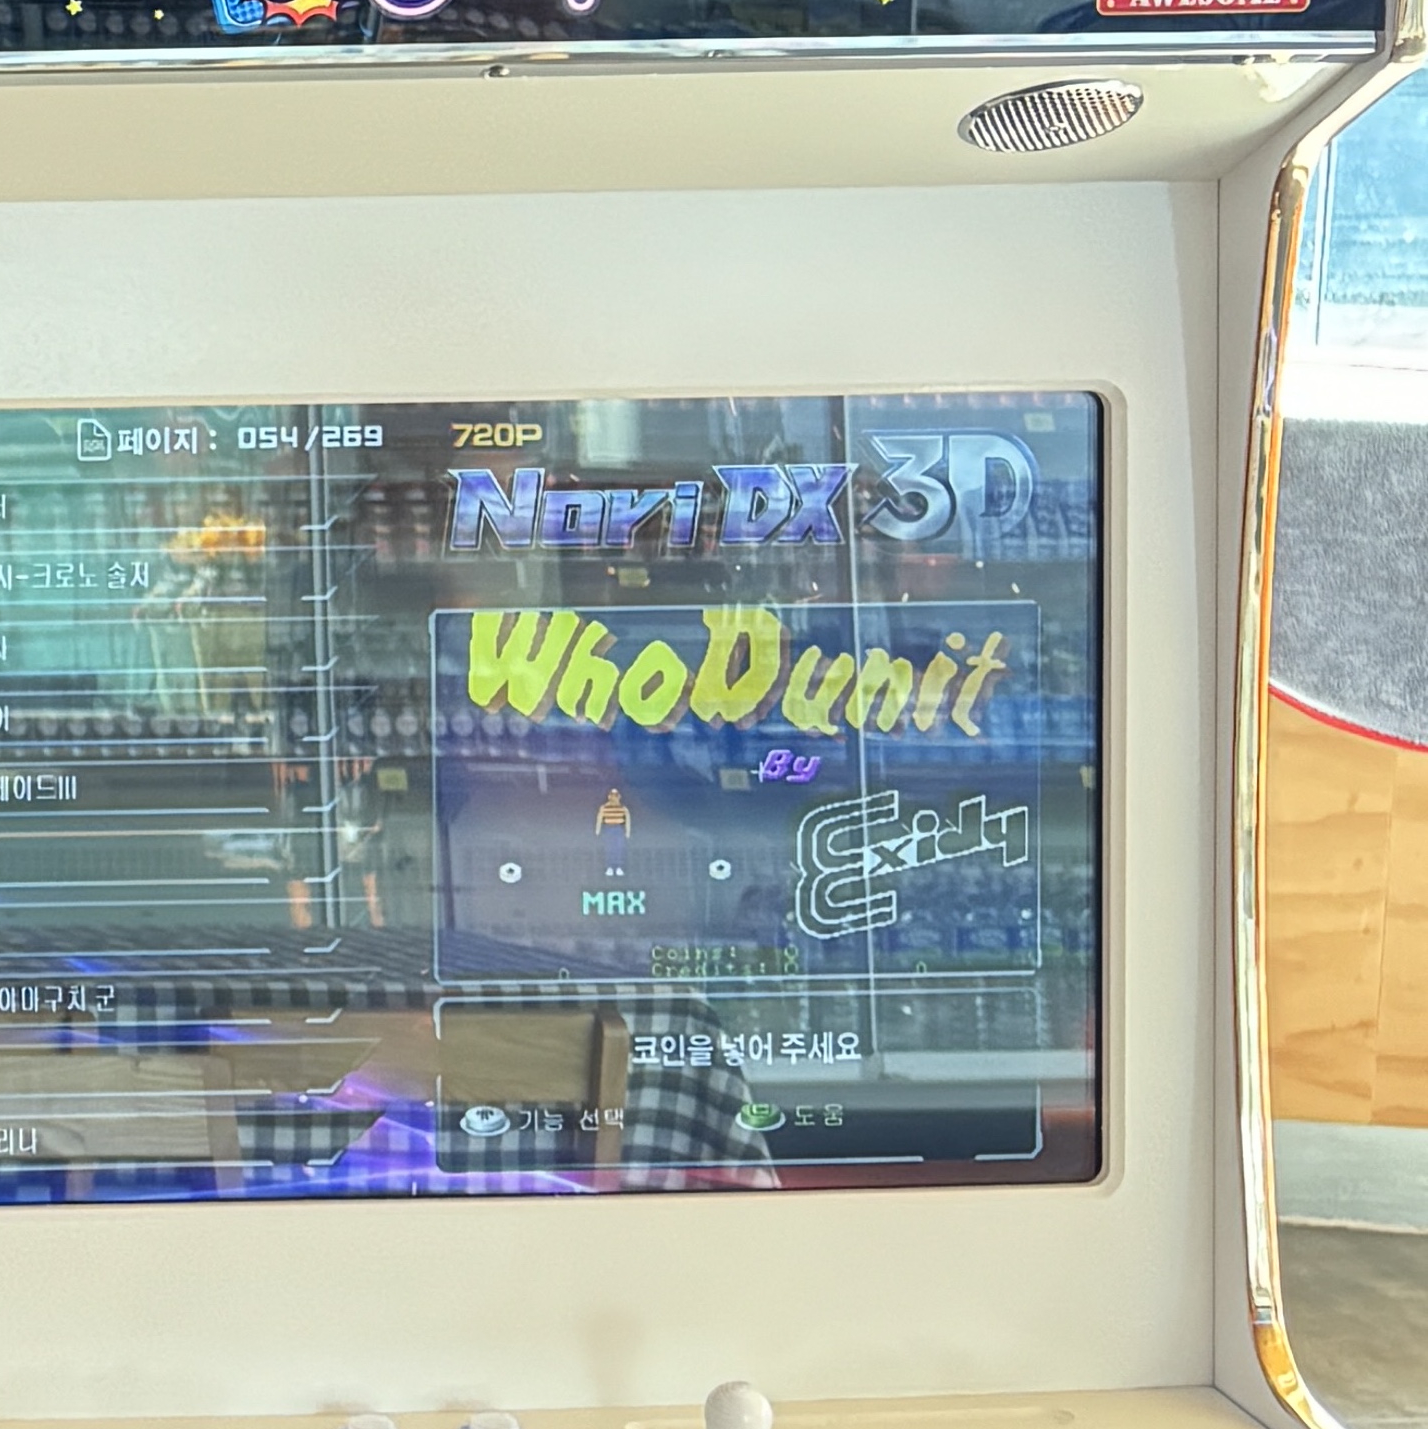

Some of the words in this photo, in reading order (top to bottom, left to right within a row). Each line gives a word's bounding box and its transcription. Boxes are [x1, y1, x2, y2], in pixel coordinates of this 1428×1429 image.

[117, 426, 198, 456] 페이지
[450, 423, 543, 448] 720P
[713, 461, 860, 549] DX
[862, 426, 1037, 542] 3D
[467, 608, 1010, 738] WhoDunit
[791, 789, 1030, 940] Exidy
[582, 889, 647, 917] MAX
[632, 1035, 713, 1067] 코인을
[720, 1033, 774, 1067] 넣어
[780, 1032, 862, 1065] 주세요
[519, 1108, 564, 1133] 기능
[579, 1107, 625, 1133] 선택
